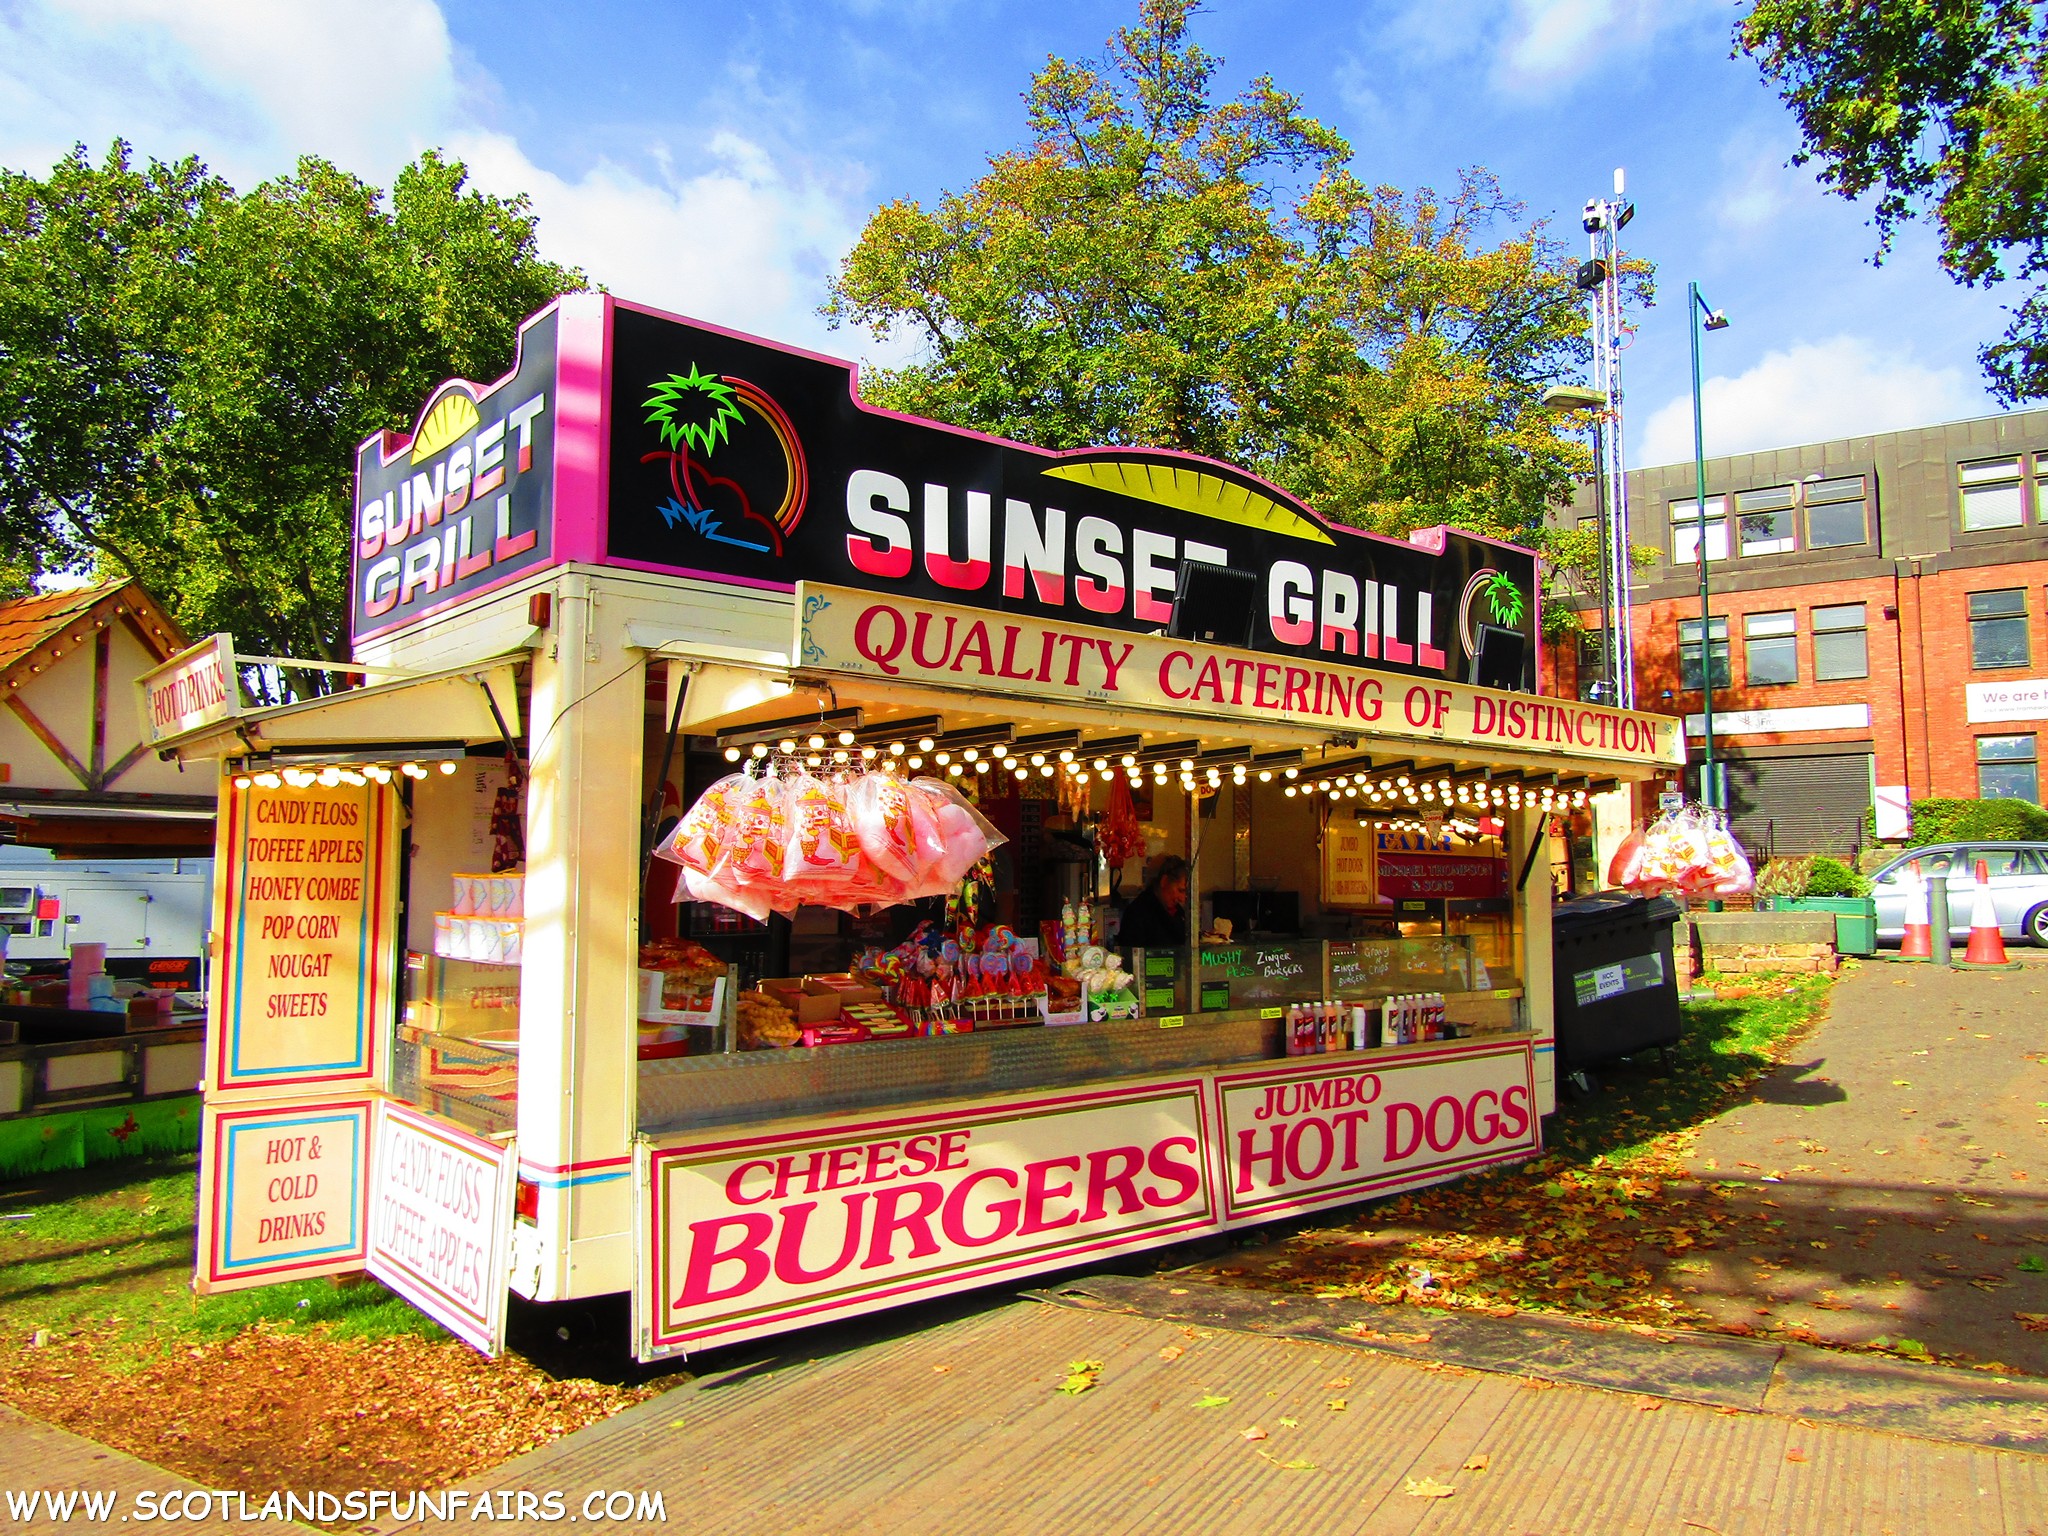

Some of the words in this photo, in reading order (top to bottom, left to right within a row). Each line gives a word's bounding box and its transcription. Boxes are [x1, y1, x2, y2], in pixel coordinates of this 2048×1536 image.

[360, 393, 545, 559] SUNSET
[364, 493, 537, 618] GRILL
[1268, 560, 1446, 671] GRILL
[153, 682, 177, 728] HOT
[178, 660, 227, 717] DRINKS
[854, 604, 1135, 692] QUALITY
[1158, 649, 1384, 723] CATERING
[1404, 686, 1453, 729] OF
[1472, 695, 1658, 756] DISTINCTION
[1983, 693, 2008, 703] We
[2013, 692, 2039, 702] are
[257, 799, 310, 824] CANDY
[312, 801, 359, 826] FLOSS
[248, 838, 306, 862] TOFFEE
[306, 840, 364, 863] APPLES
[1377, 863, 1426, 877] MICHAEL
[248, 876, 305, 901] HONEY
[306, 877, 361, 901] COMBE
[1424, 880, 1454, 892] SONS
[261, 915, 294, 939] POP
[297, 915, 340, 939] CORN
[267, 953, 333, 979] NOUGAT
[1201, 949, 1243, 968] MUSHY
[1599, 979, 1620, 990] EVENTS
[266, 992, 328, 1018] SWEETS
[1254, 1073, 1382, 1121] JUMBO
[266, 1137, 306, 1164] HOT
[308, 1135, 322, 1160] &
[1235, 1109, 1369, 1195] HOT
[1383, 1085, 1529, 1163] DOGS
[391, 1131, 436, 1198] CANDY
[435, 1151, 482, 1224] FLOSS
[725, 1129, 972, 1206] CHEESE
[268, 1173, 318, 1203] COLD
[258, 1210, 326, 1244] DRINKS
[672, 1136, 1201, 1310] BURGERS
[382, 1194, 426, 1268] TOFFEE
[427, 1223, 482, 1306] APPLES
